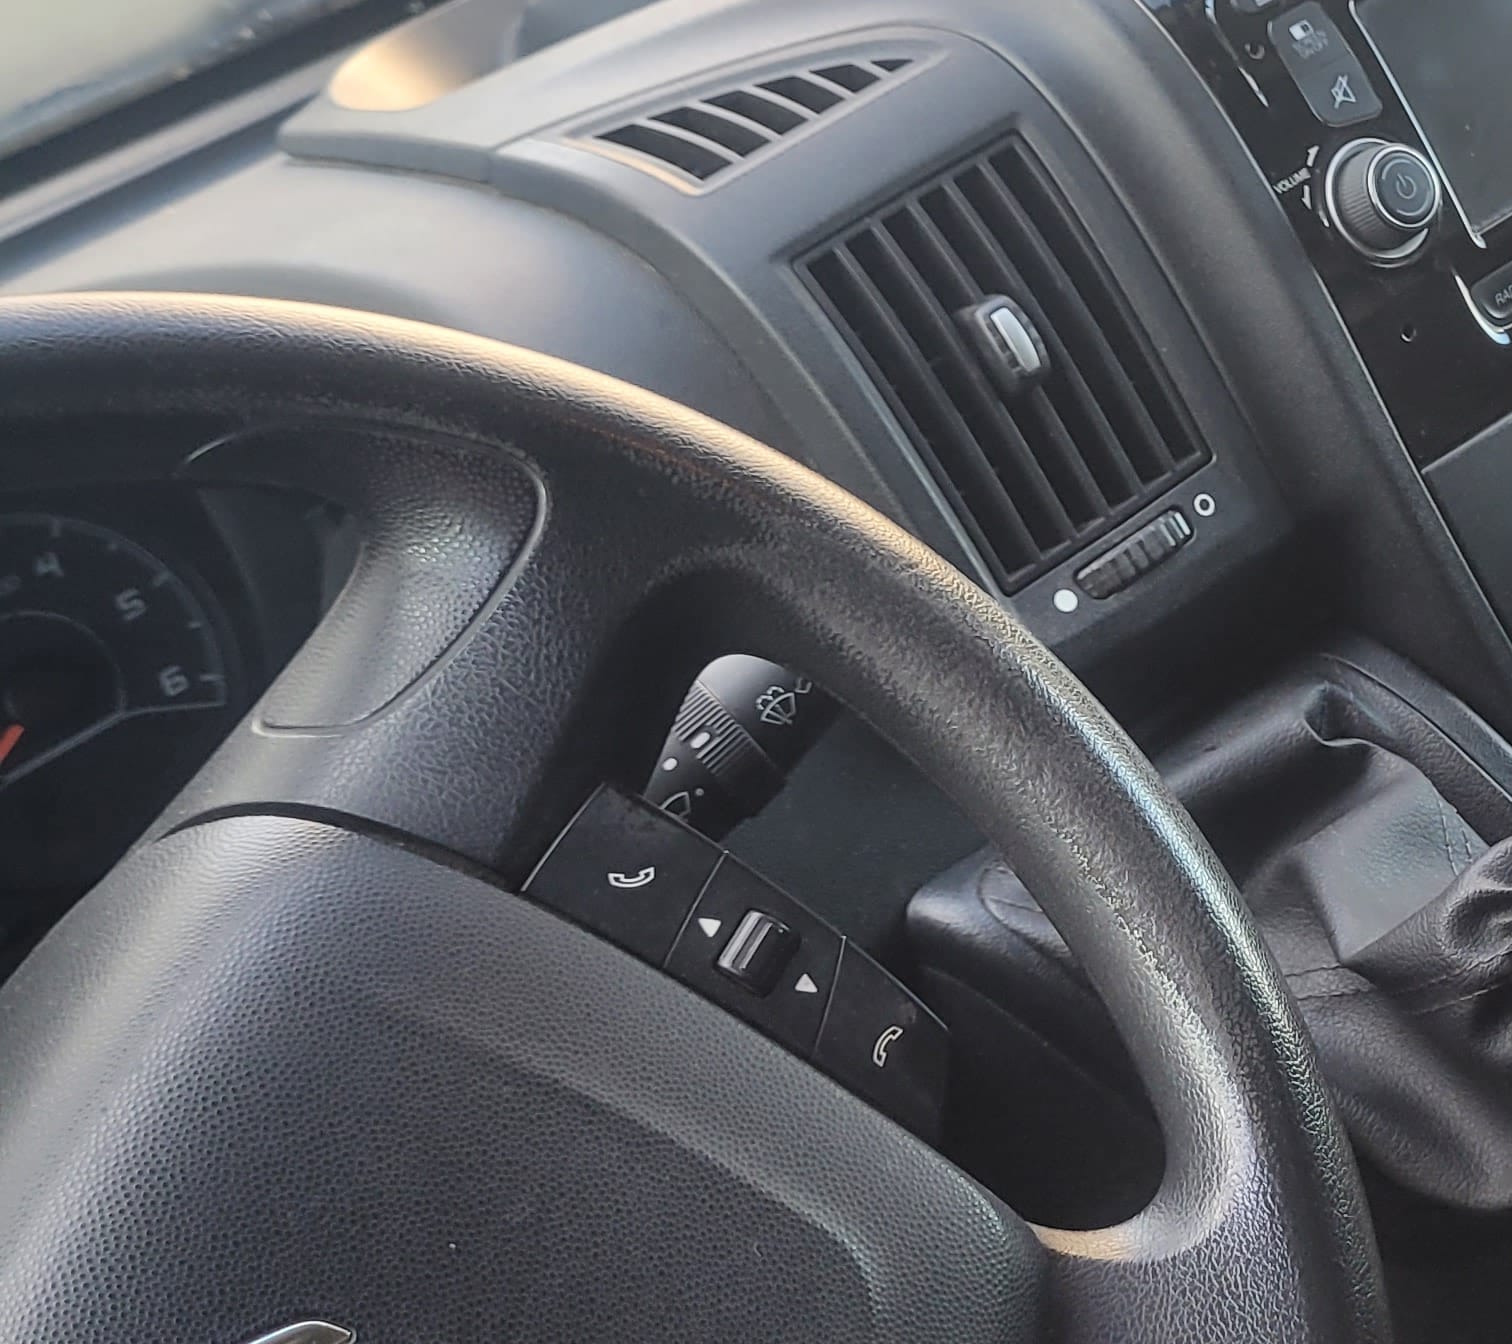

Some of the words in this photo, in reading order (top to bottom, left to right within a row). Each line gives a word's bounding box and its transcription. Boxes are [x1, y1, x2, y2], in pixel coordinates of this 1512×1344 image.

[1273, 167, 1311, 194] VOLUME
[115, 587, 147, 622] 5
[159, 665, 189, 697] 6
